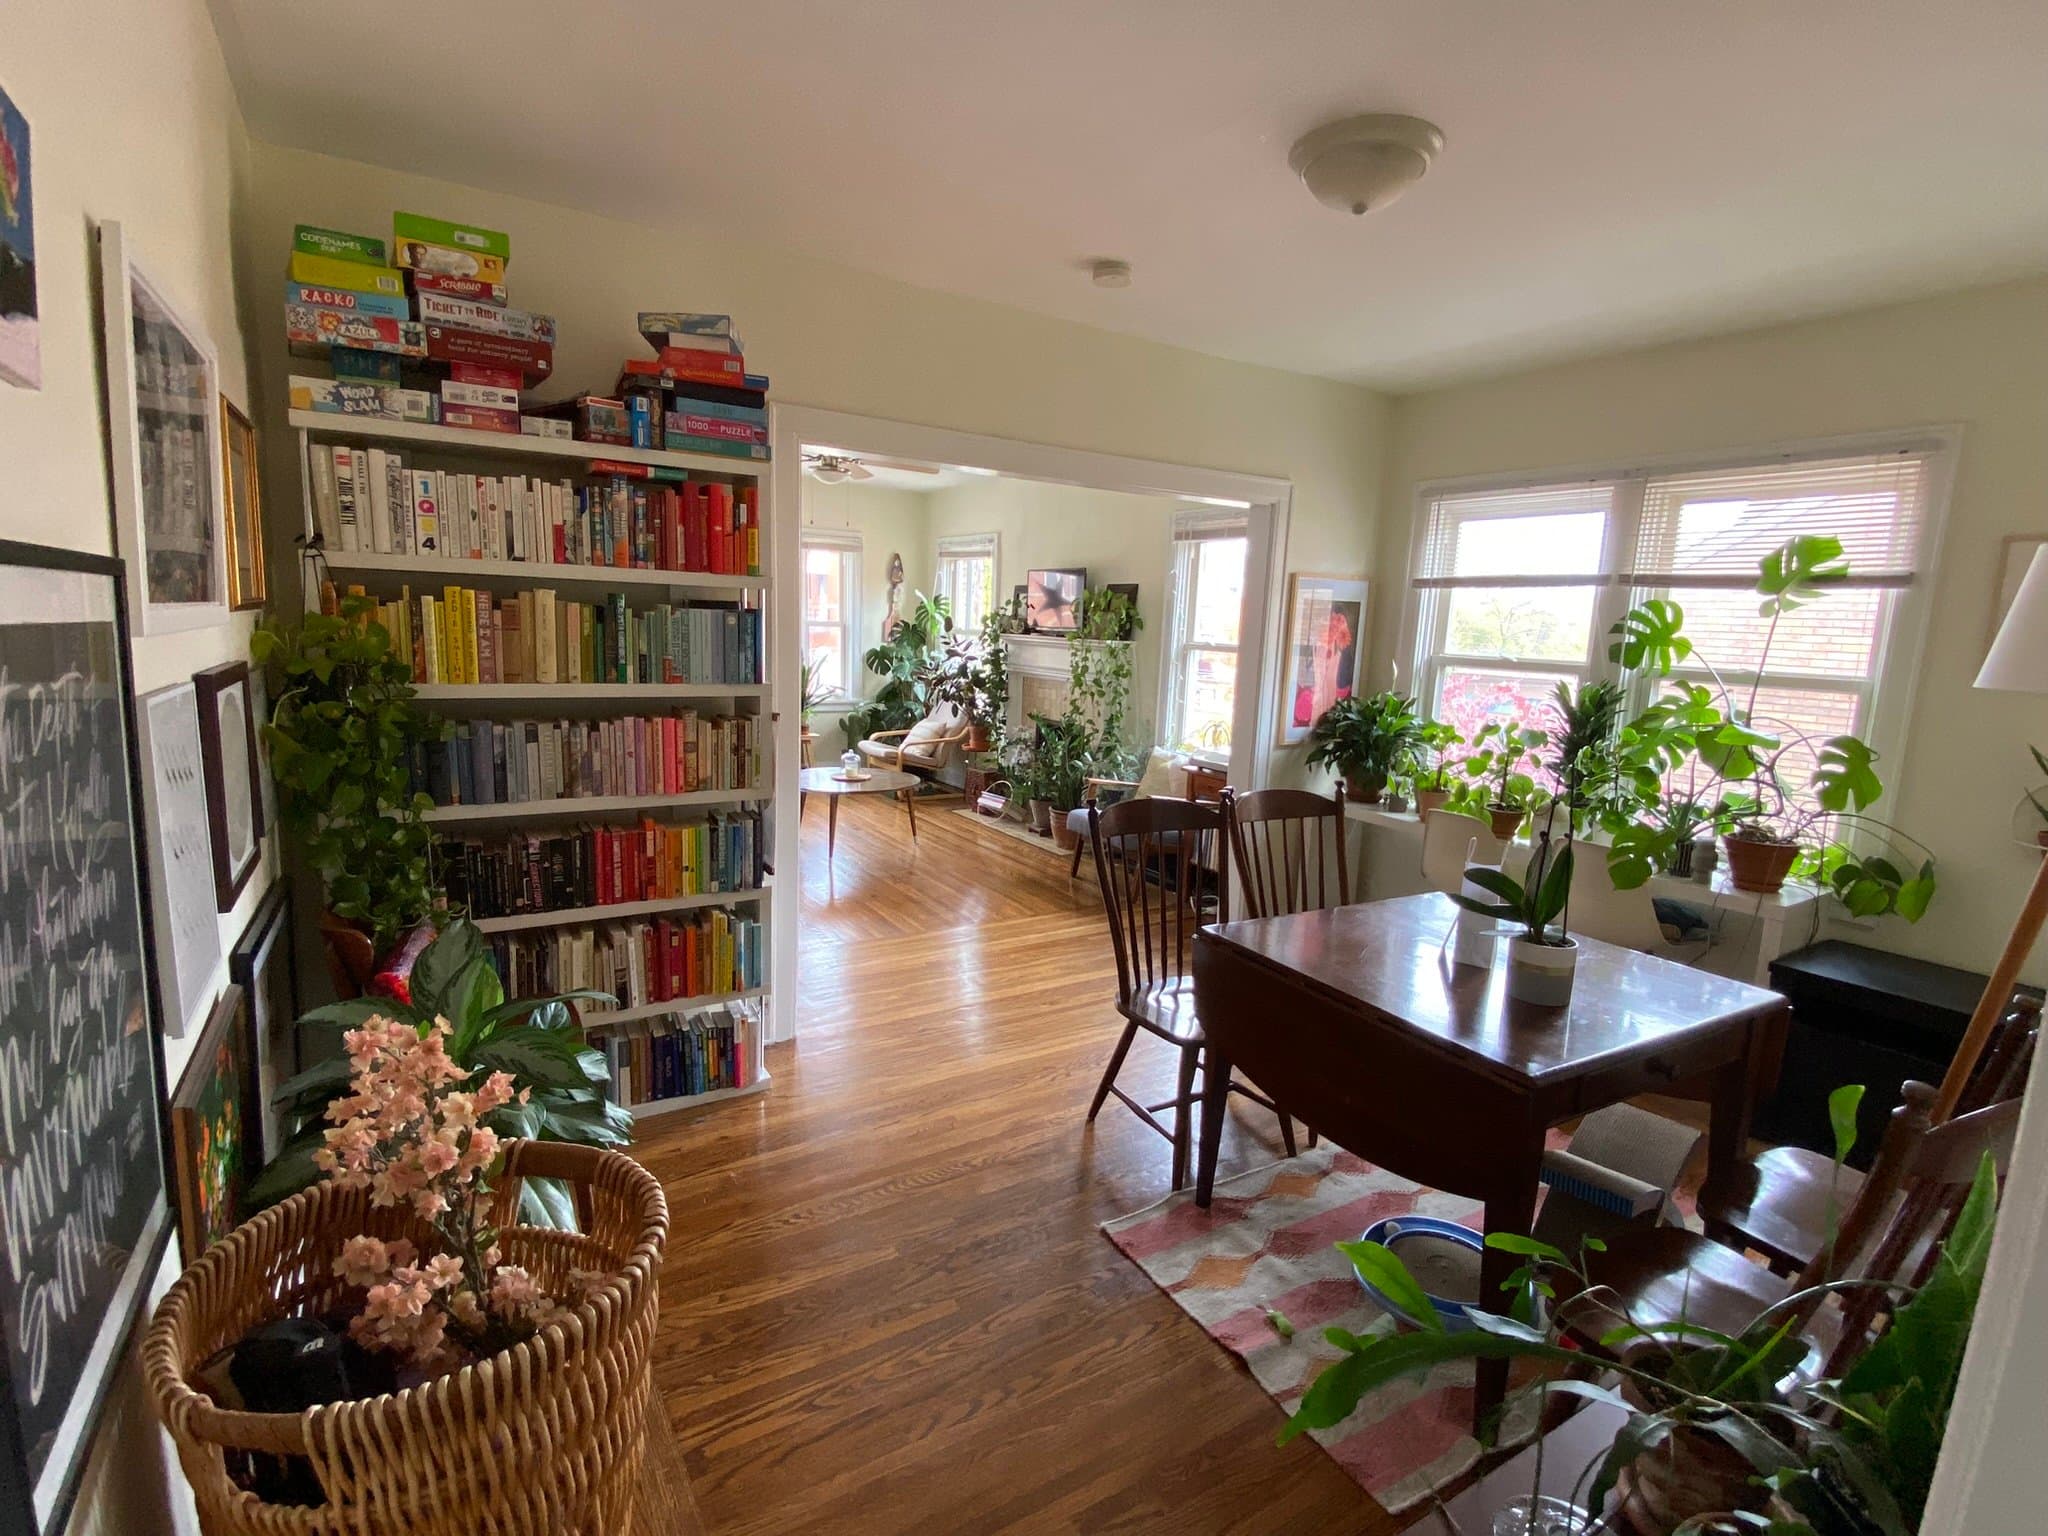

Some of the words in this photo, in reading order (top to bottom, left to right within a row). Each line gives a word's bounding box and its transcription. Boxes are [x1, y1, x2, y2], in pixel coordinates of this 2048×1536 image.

[300, 232, 362, 251] CODENAMES
[300, 288, 356, 309] RACKO
[423, 297, 463, 316] TICKET
[475, 305, 499, 321] RIDE
[344, 325, 375, 338] AZUL
[340, 386, 375, 400] WORD
[344, 399, 381, 413] SLAM
[687, 420, 709, 431] 1000
[720, 425, 753, 437] PUZZLE
